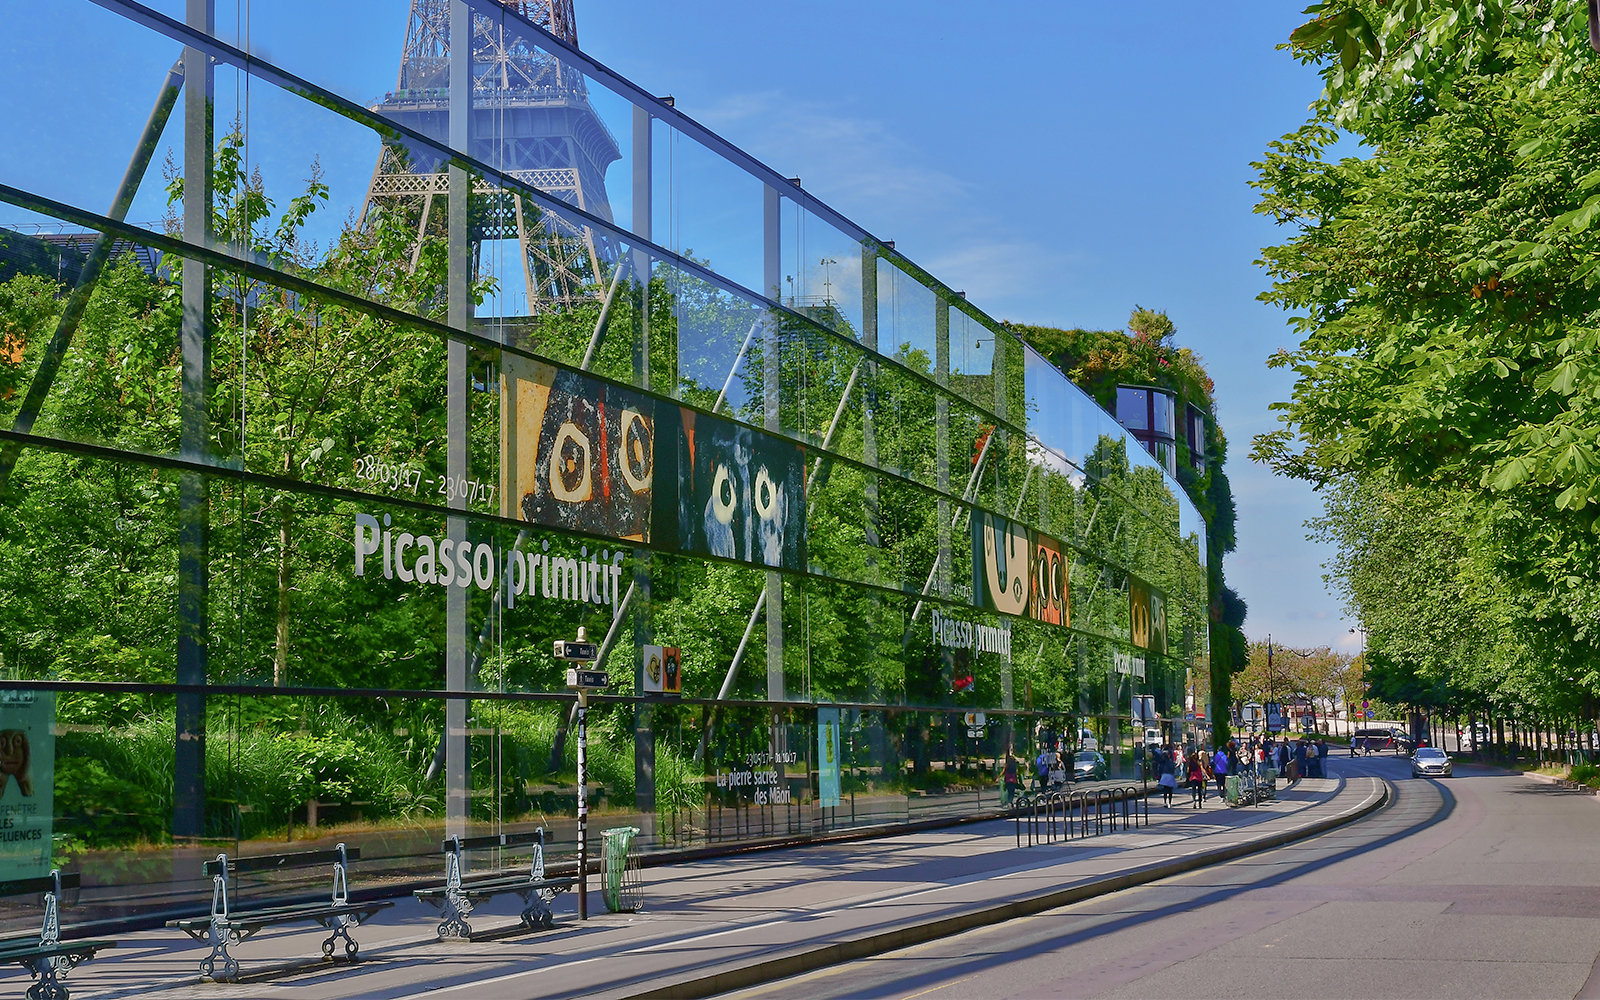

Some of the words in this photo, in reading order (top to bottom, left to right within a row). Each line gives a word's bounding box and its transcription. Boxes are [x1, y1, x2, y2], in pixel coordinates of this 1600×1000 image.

[356, 454, 421, 495] 28/03/17
[438, 474, 495, 508] 23/07/17
[355, 512, 495, 590] Picasso
[507, 539, 624, 620] primitif
[932, 608, 973, 649] Picasso
[975, 617, 1012, 664] primitif
[716, 768, 727, 787] La
[728, 767, 752, 791] pierre
[753, 766, 778, 785] sacrée
[754, 787, 768, 805] des
[769, 785, 791, 804] Māori
[0, 802, 38, 816] FENÊTRE
